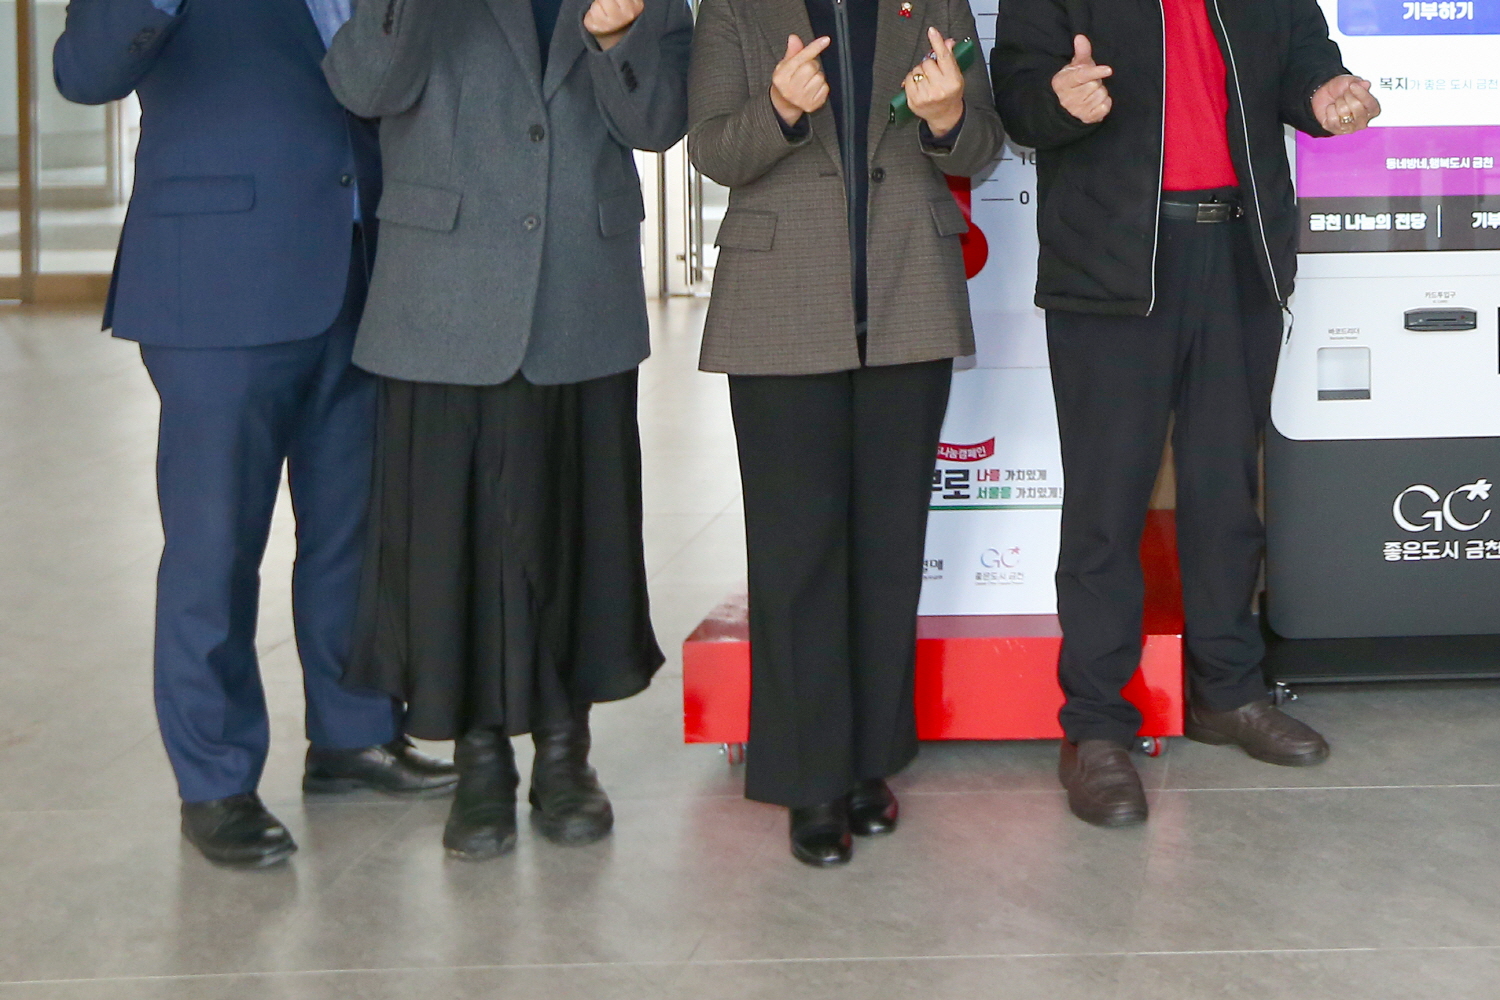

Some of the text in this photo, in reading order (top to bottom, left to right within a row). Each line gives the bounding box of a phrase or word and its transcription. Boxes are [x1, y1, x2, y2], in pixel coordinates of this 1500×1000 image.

[1402, 1, 1474, 20] 기부하기
[1424, 78, 1446, 90] 좋은
[1450, 78, 1472, 90] 도시
[1476, 78, 1498, 90] 금천
[1472, 156, 1493, 169] 금천
[1019, 191, 1030, 205] 0
[1309, 214, 1342, 231] 금천
[1344, 213, 1392, 231] 나눔의
[1425, 291, 1456, 299] 카드투입구
[977, 469, 1047, 482] 나를 가치있게
[1016, 486, 1063, 499] 가치있게!
[1392, 479, 1492, 532] GC
[980, 547, 1021, 568] GC
[1383, 541, 1459, 561] 좋은도시
